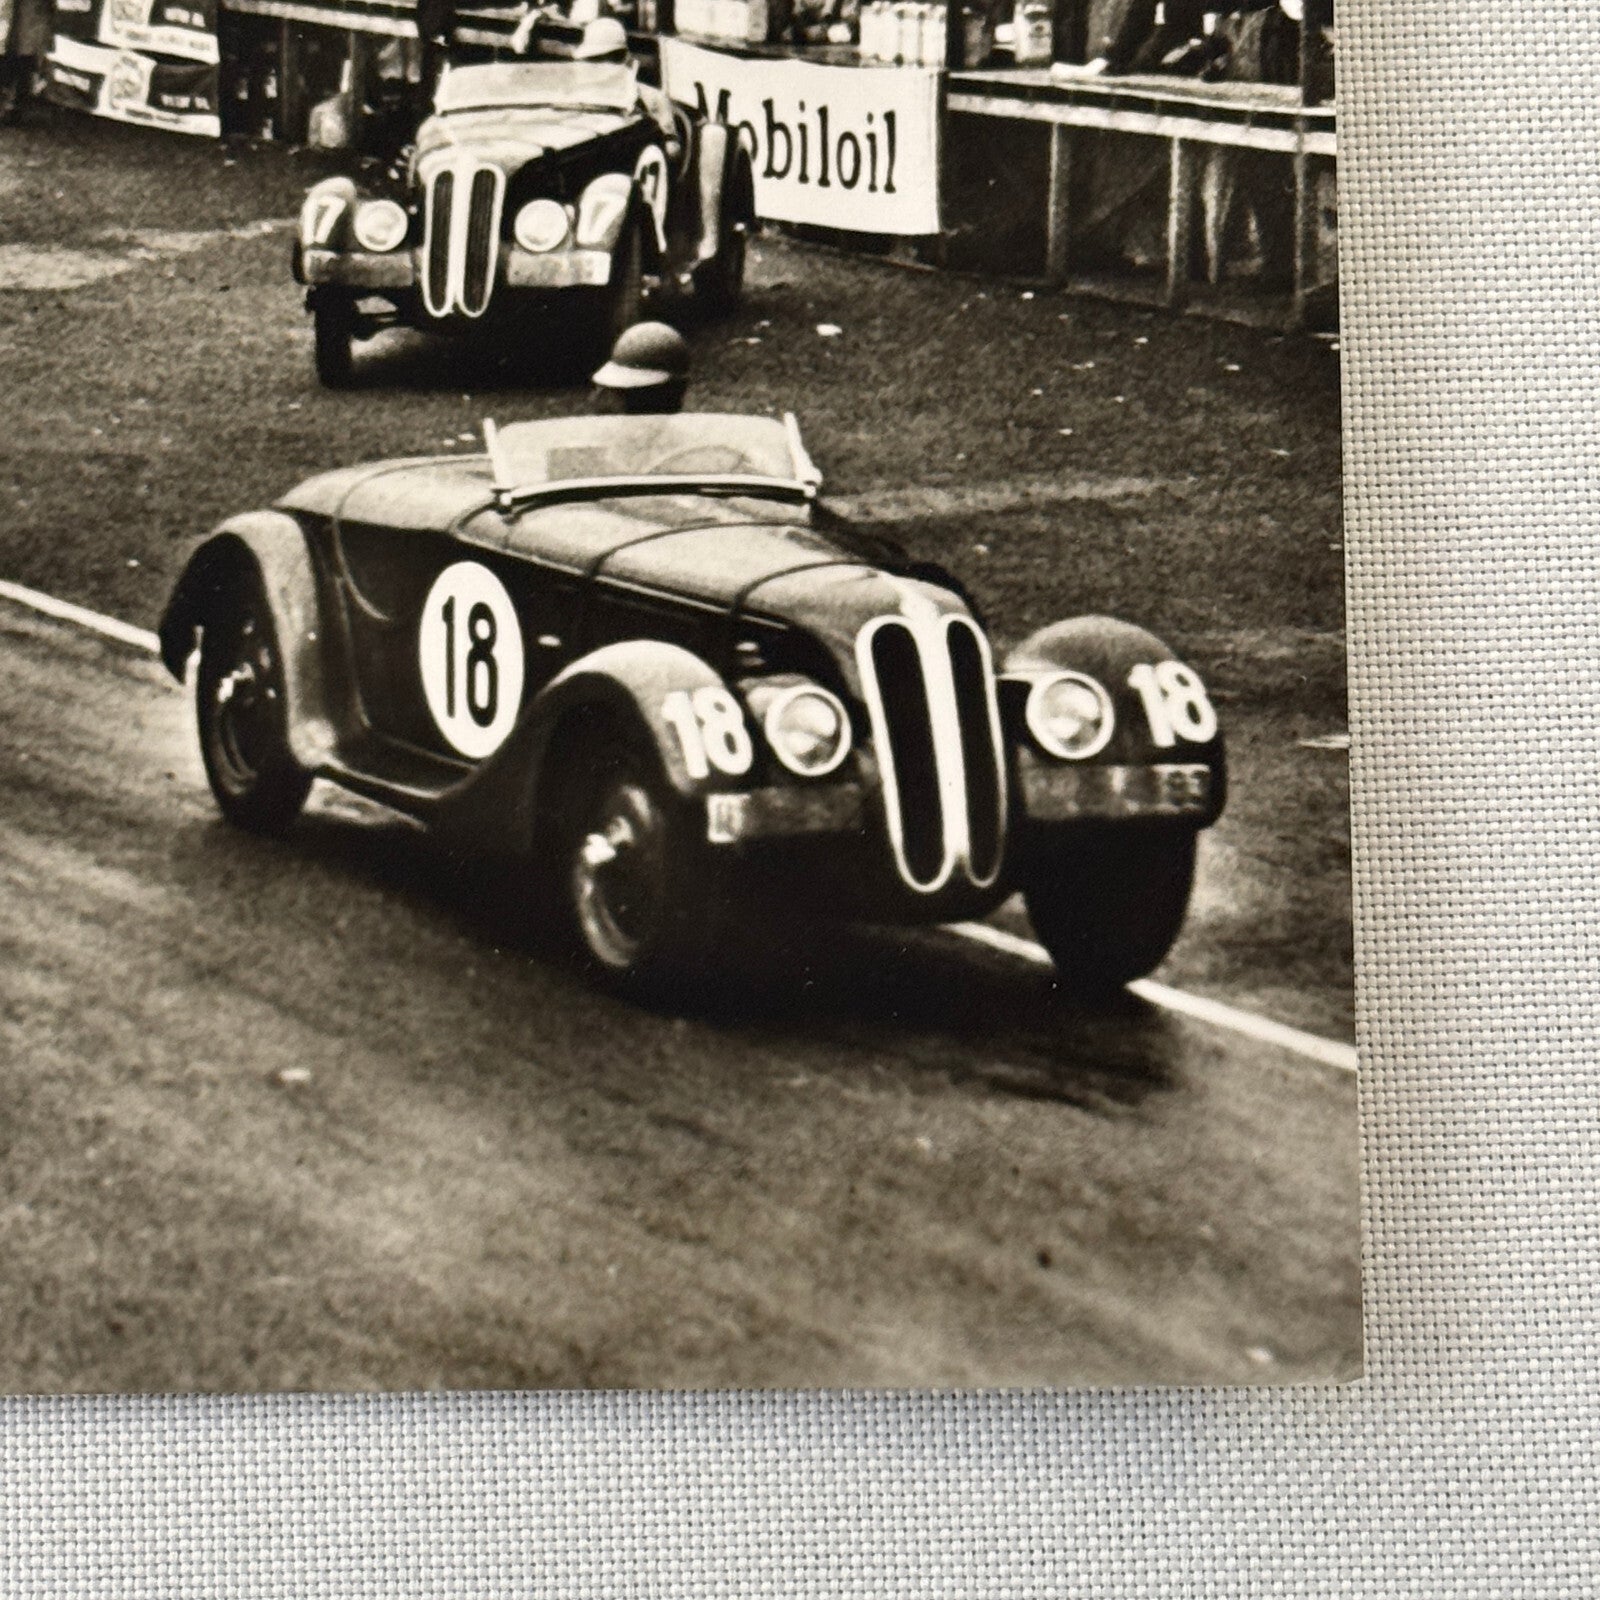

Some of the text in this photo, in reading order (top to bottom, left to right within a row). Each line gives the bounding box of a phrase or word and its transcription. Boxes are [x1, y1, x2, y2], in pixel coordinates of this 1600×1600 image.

[442, 595, 499, 728] 18
[1128, 660, 1218, 748] 18
[661, 686, 753, 779] 18
